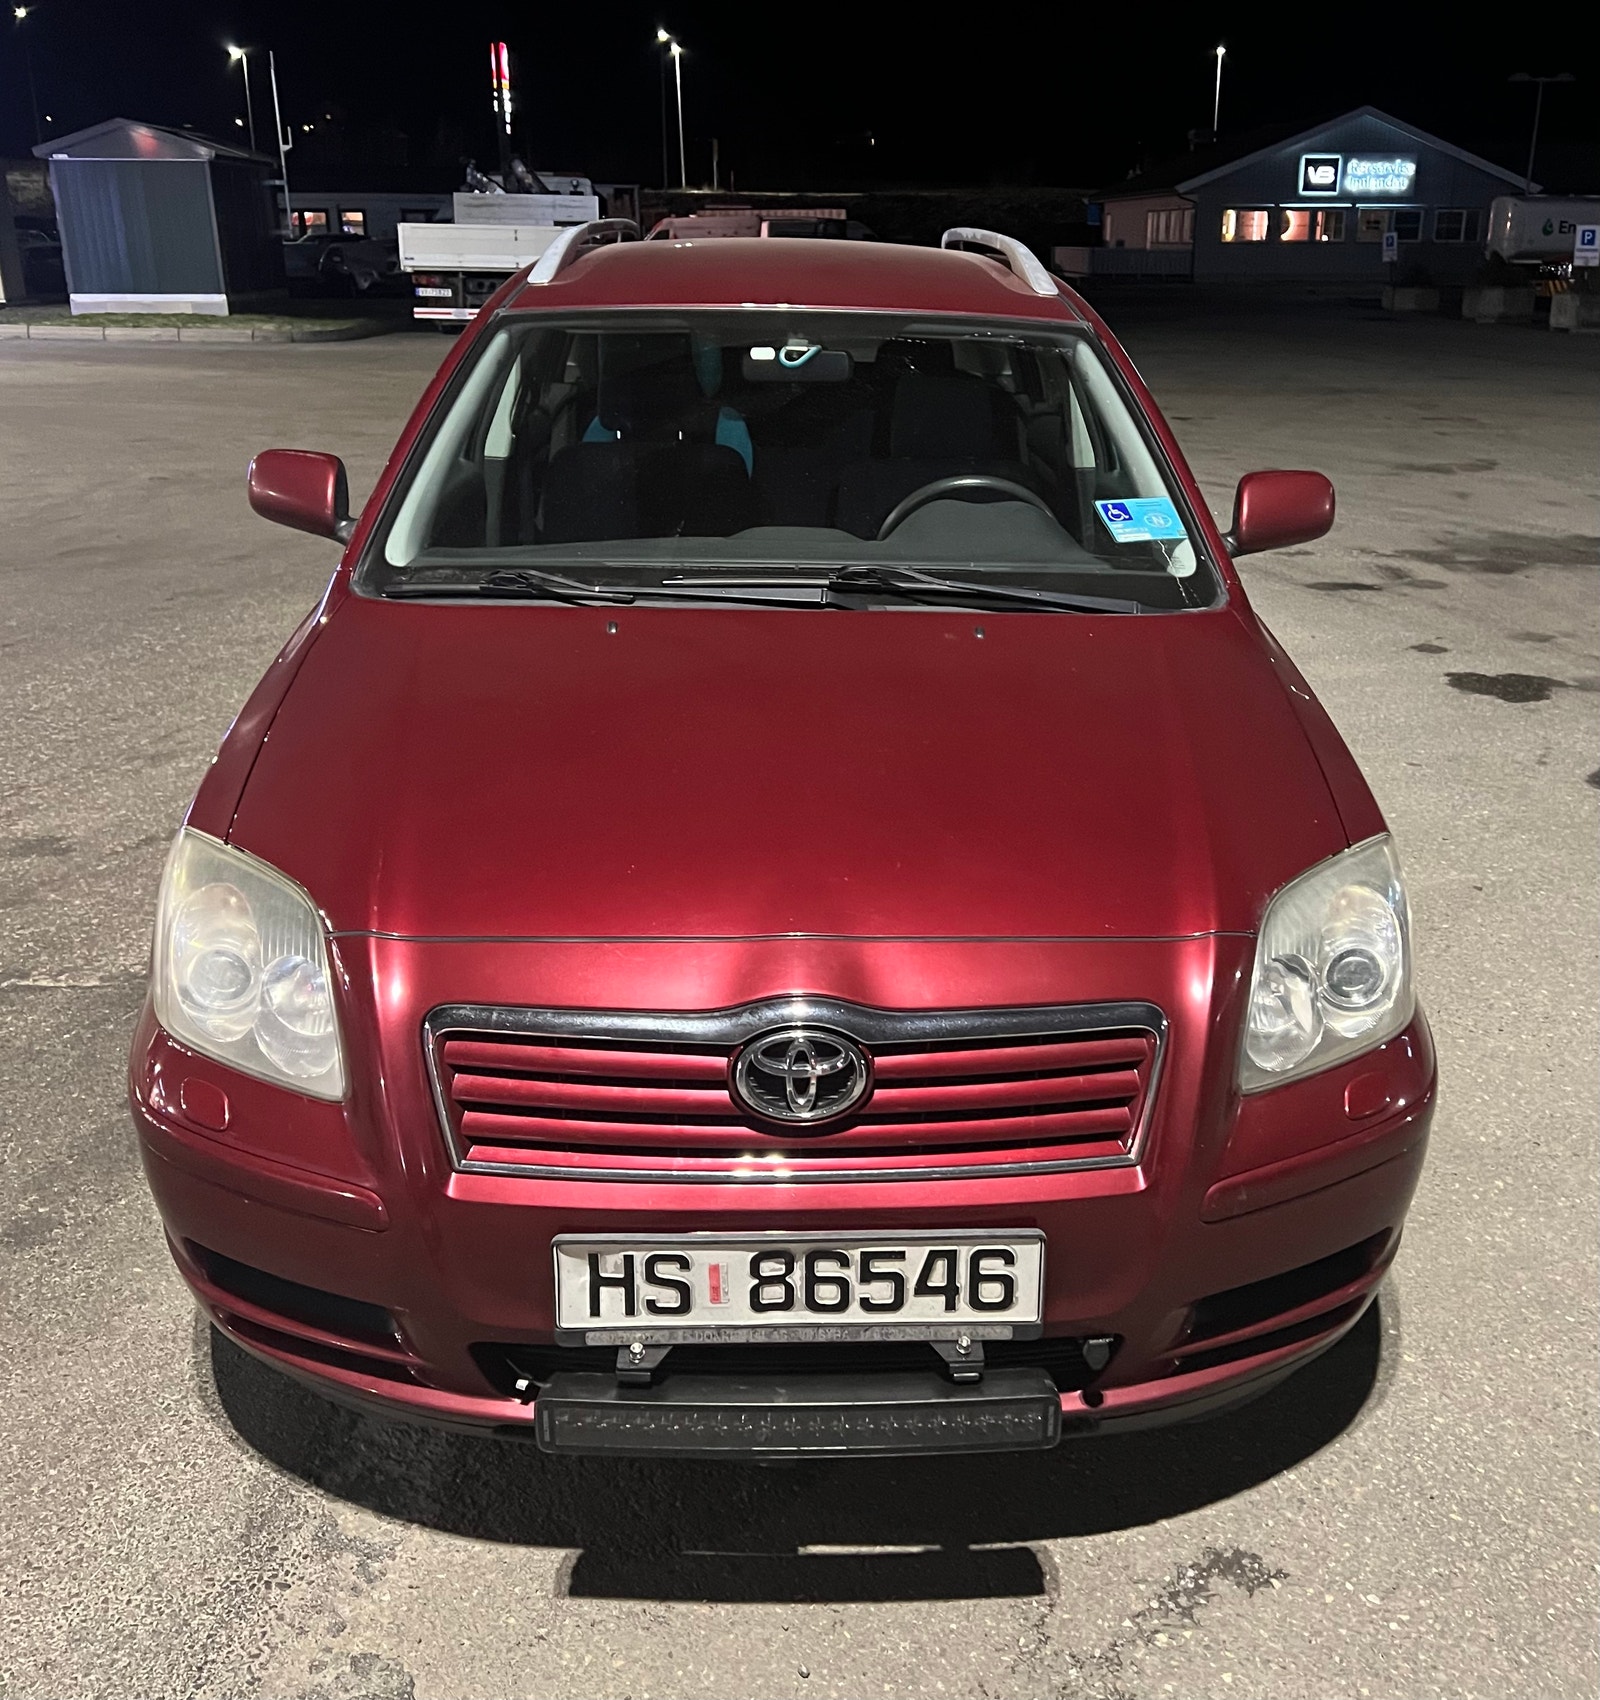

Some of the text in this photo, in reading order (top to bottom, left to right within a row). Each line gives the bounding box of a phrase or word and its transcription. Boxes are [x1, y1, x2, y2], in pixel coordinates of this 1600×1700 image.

[1307, 165, 1335, 184] VB
[1584, 231, 1593, 244] P
[587, 1248, 1017, 1317] HS 86546
